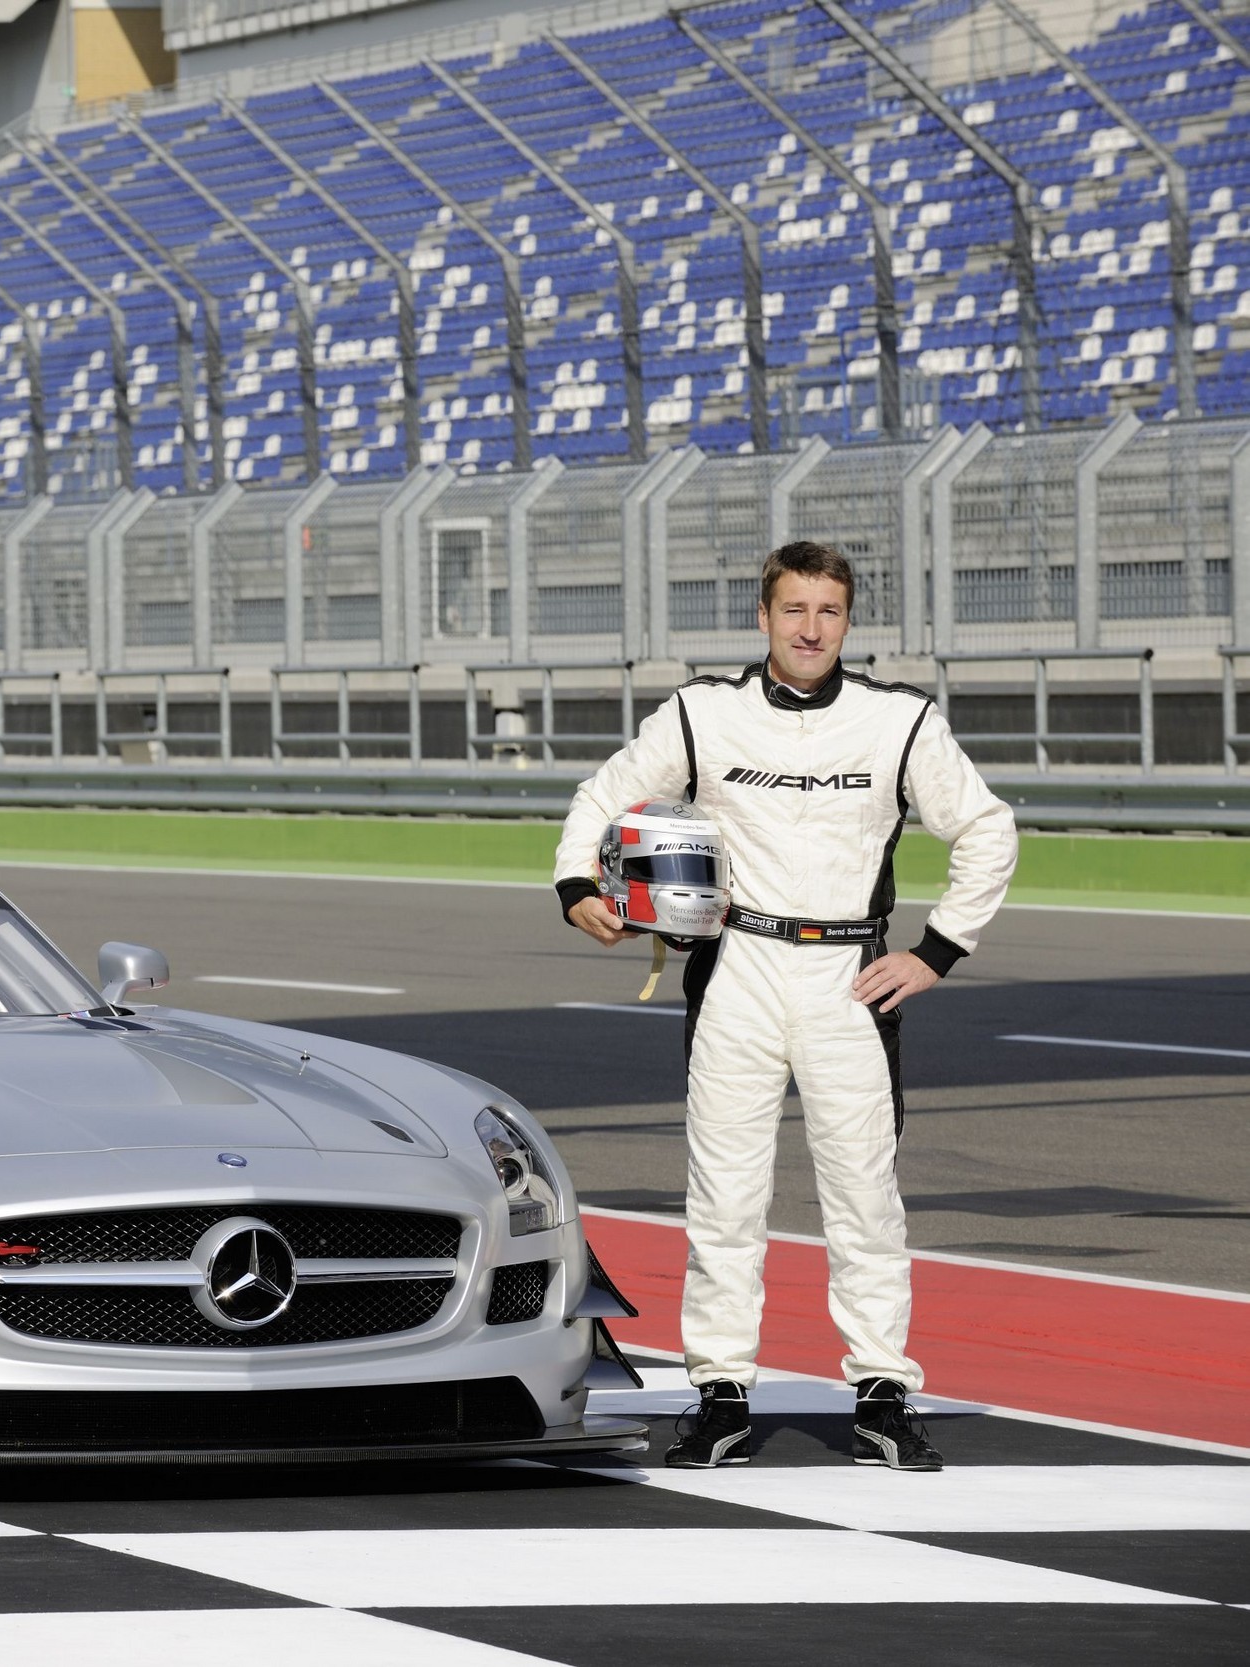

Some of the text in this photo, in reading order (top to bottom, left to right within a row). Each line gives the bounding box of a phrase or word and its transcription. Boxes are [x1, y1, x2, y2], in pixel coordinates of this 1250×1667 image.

[768, 772, 872, 792] AMG
[678, 843, 721, 856] AMG
[826, 927, 874, 936] Bernd Schneider
